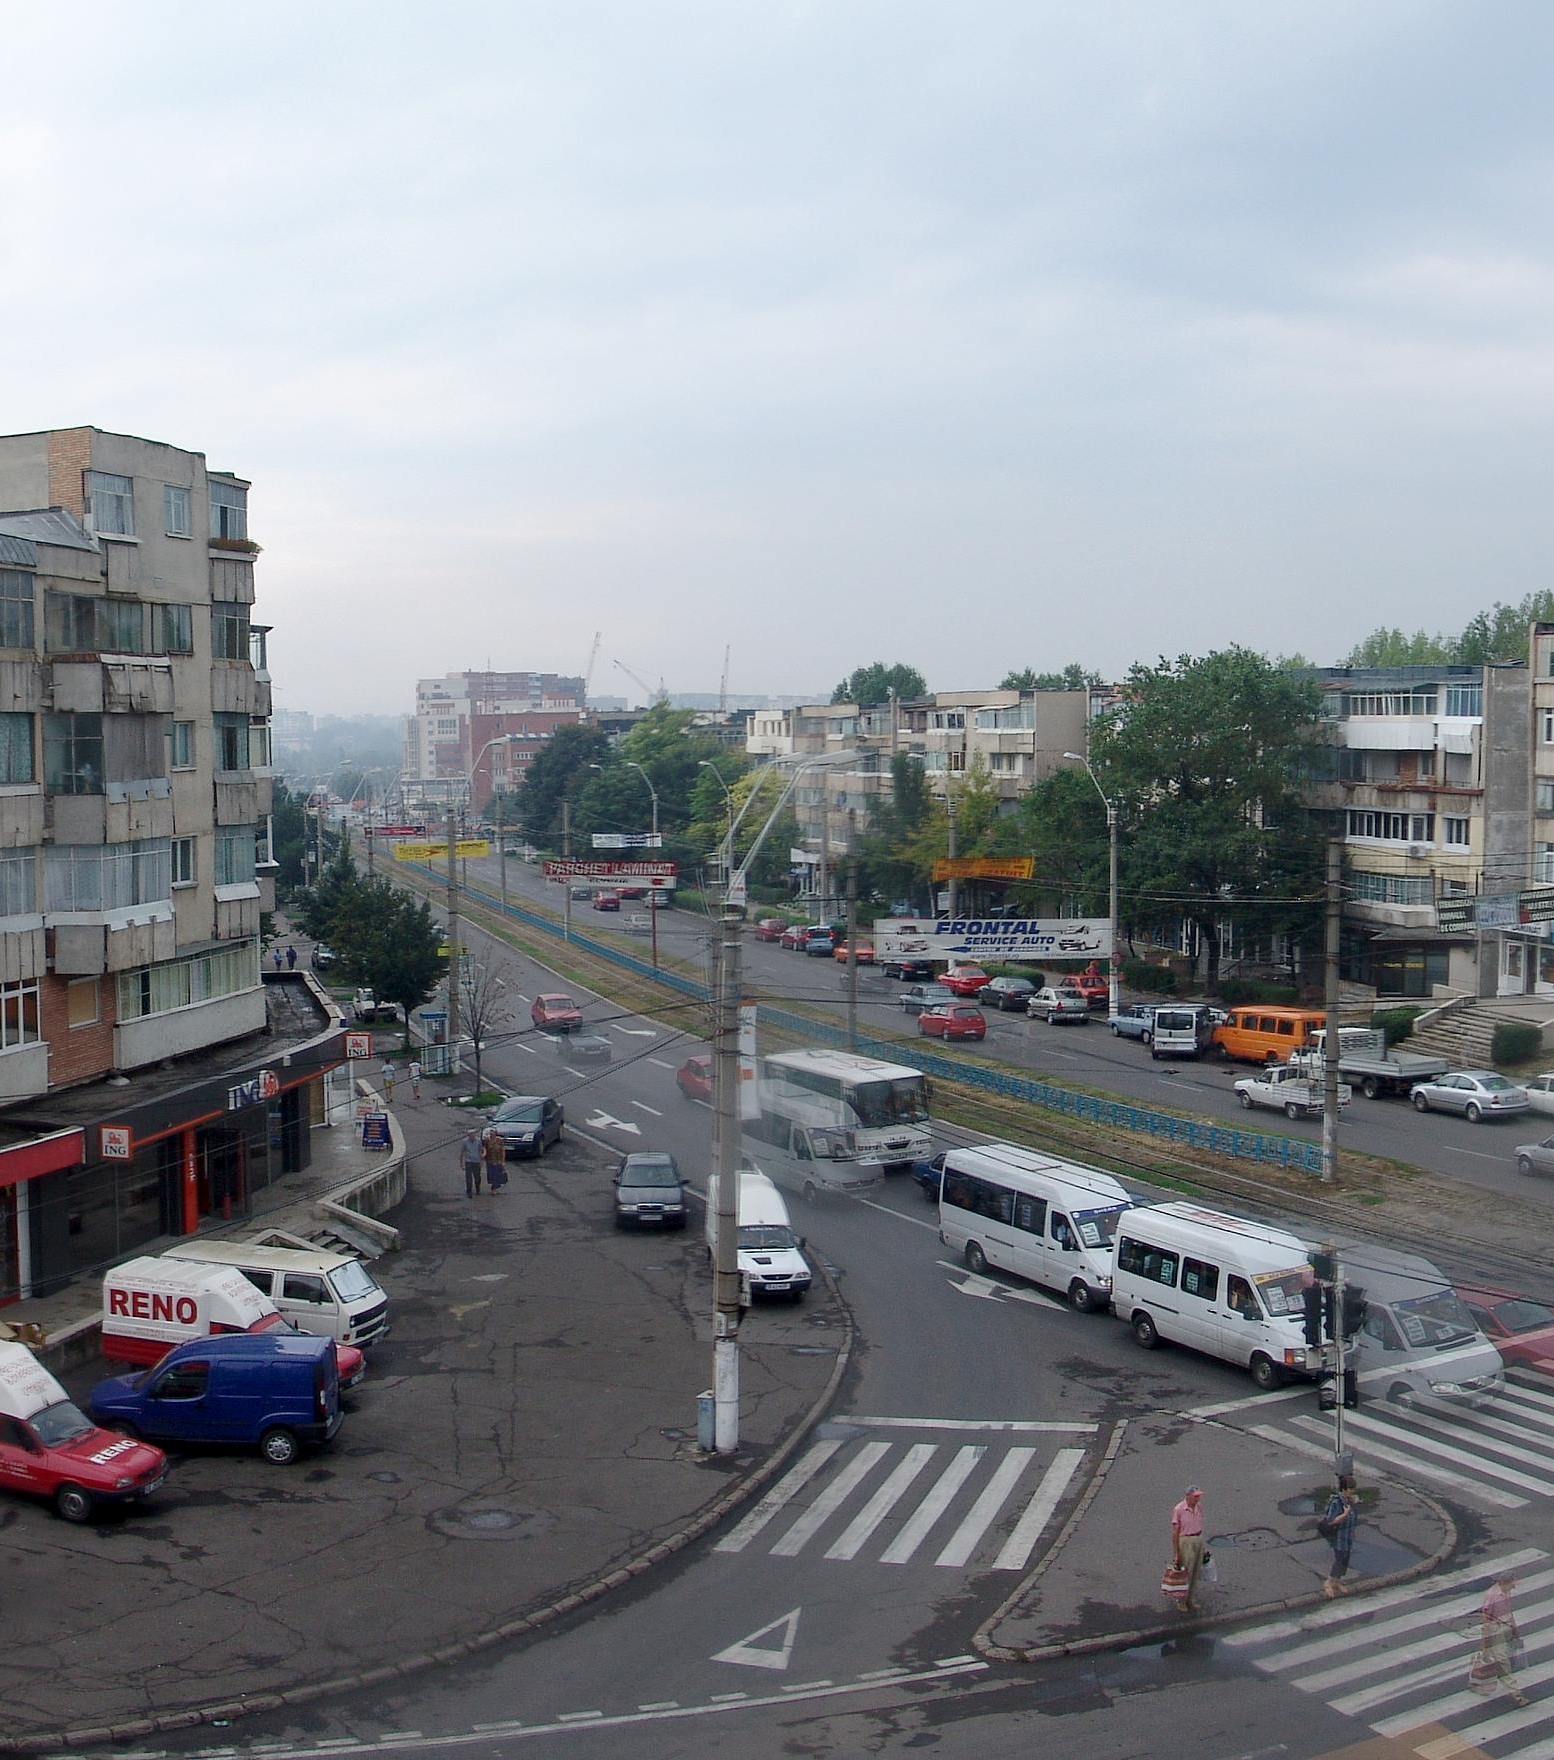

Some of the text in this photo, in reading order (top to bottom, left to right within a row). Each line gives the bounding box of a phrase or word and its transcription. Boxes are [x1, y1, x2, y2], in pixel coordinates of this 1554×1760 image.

[935, 921, 1040, 935] FRONTAL
[963, 936, 1055, 945] SERVICE AUTO
[103, 1144, 127, 1156] ING
[109, 1288, 198, 1324] RENO
[89, 1439, 140, 1466] RENO
